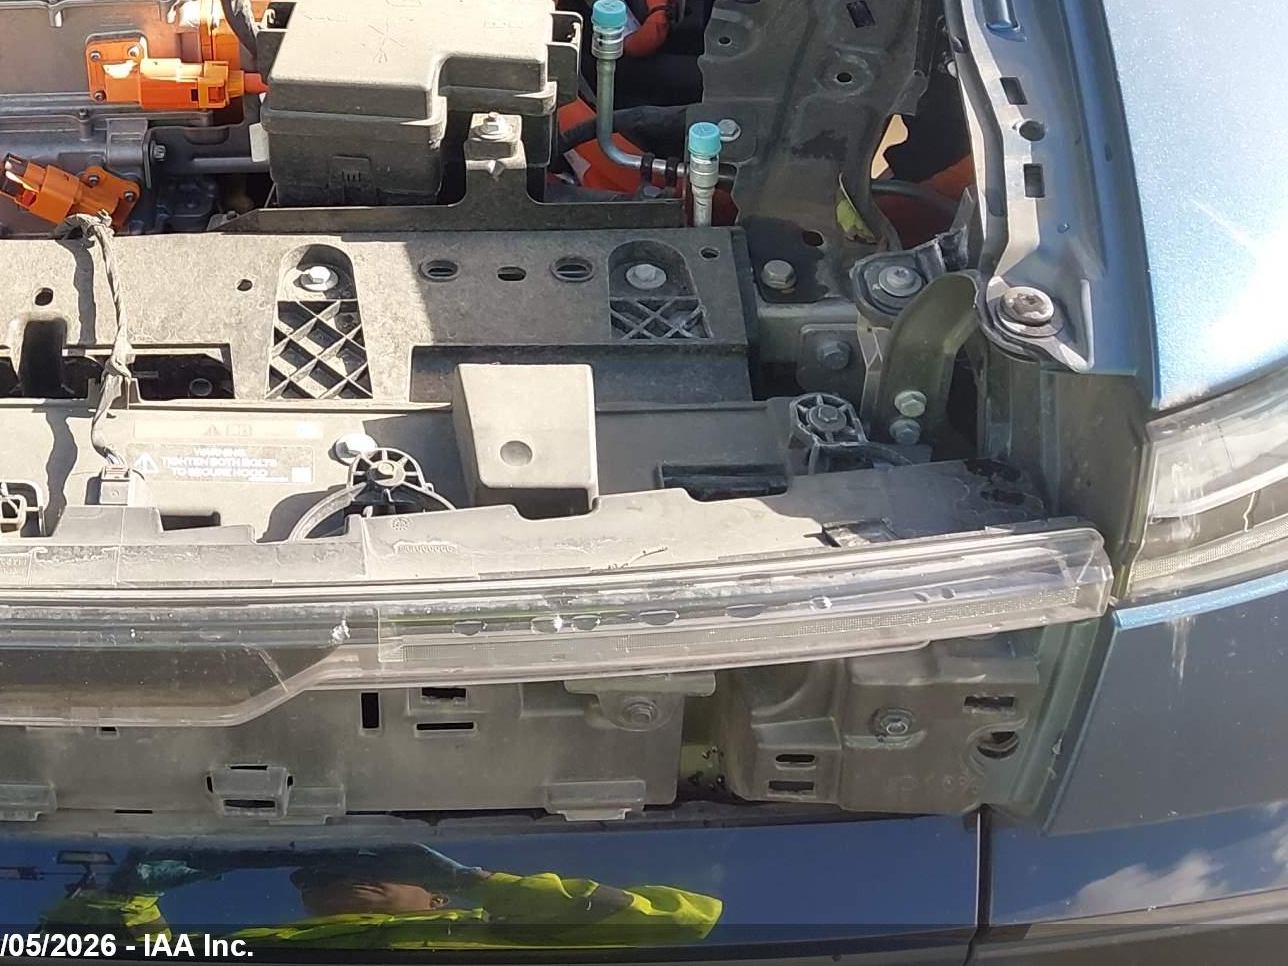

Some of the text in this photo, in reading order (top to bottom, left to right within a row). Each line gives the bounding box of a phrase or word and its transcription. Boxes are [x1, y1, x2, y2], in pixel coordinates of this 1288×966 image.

[160, 456, 278, 467] TIGHTEN BOTH BOLTS
[171, 466, 187, 476] TO
